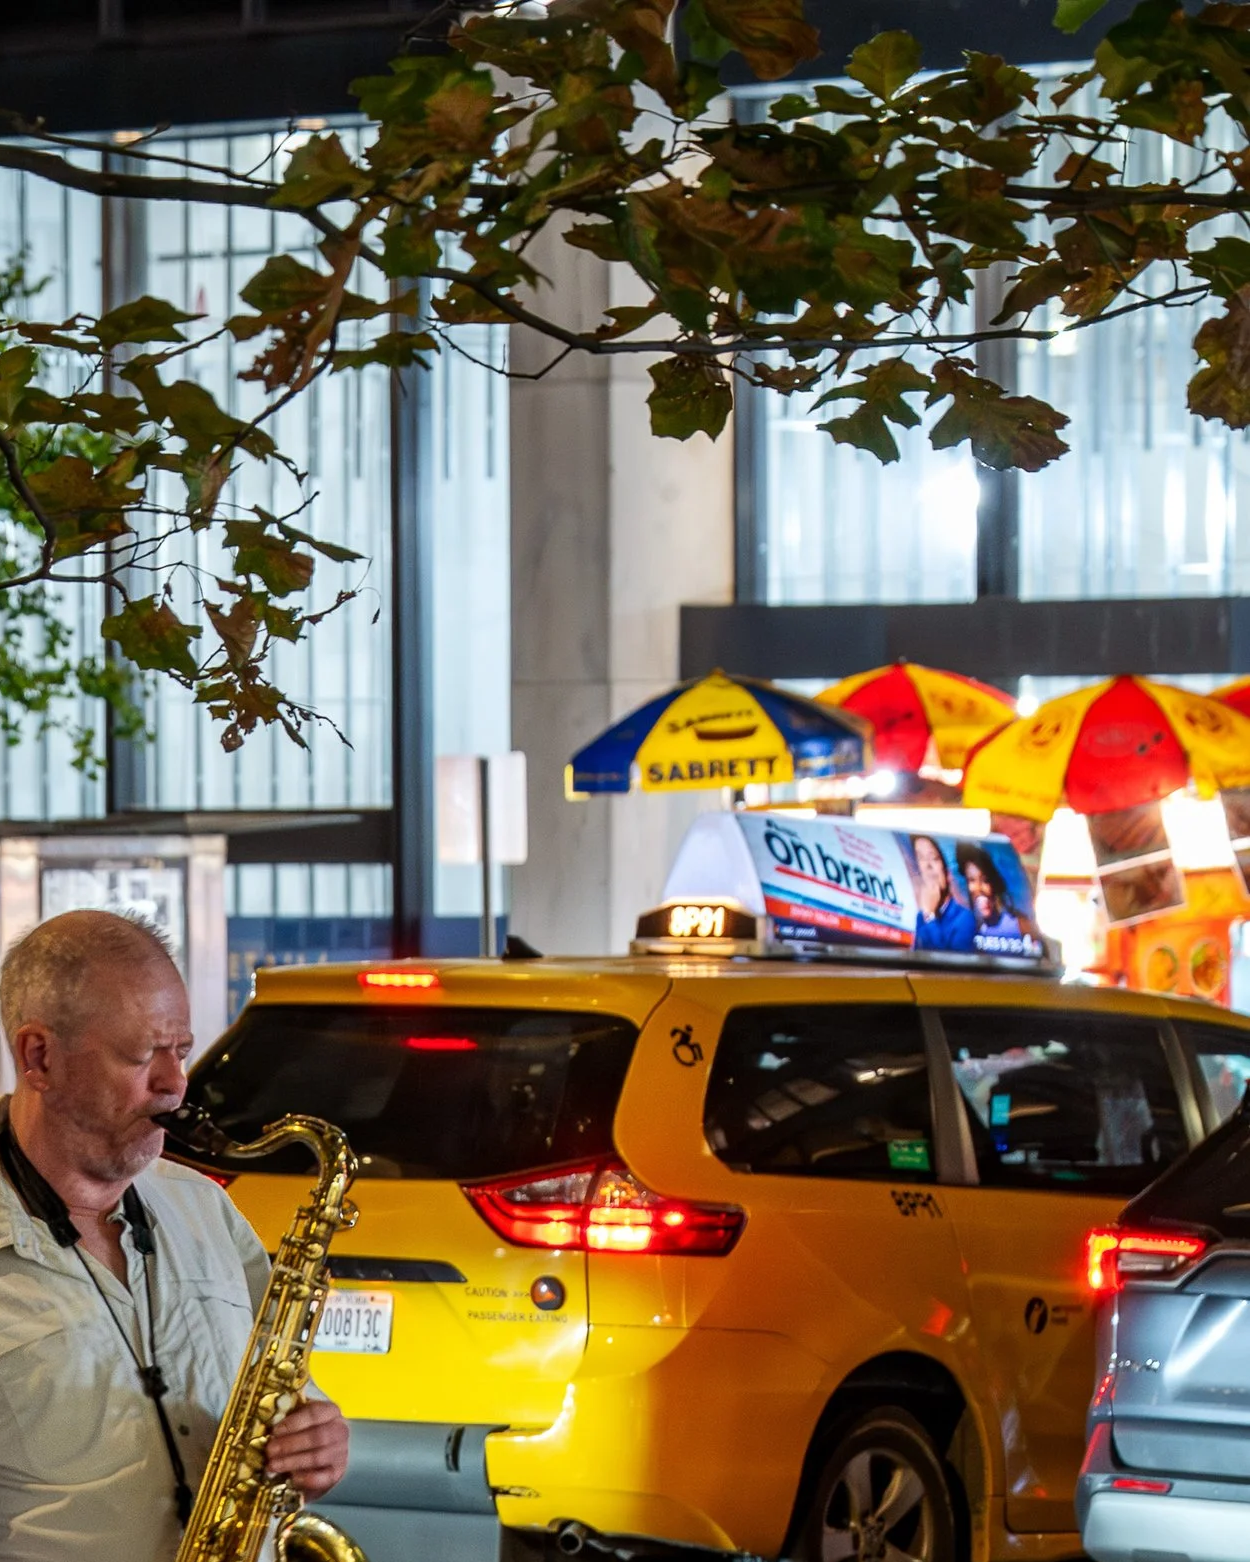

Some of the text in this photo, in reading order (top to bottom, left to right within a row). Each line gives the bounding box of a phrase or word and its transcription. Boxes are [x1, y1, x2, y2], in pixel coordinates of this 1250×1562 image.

[647, 756, 778, 783] SABRETT
[764, 829, 818, 875] On
[669, 906, 725, 937] 8P91
[465, 1287, 508, 1298] CAUTION
[315, 1307, 382, 1338] 00813C
[467, 1309, 569, 1324] PASSENGER EXITING
